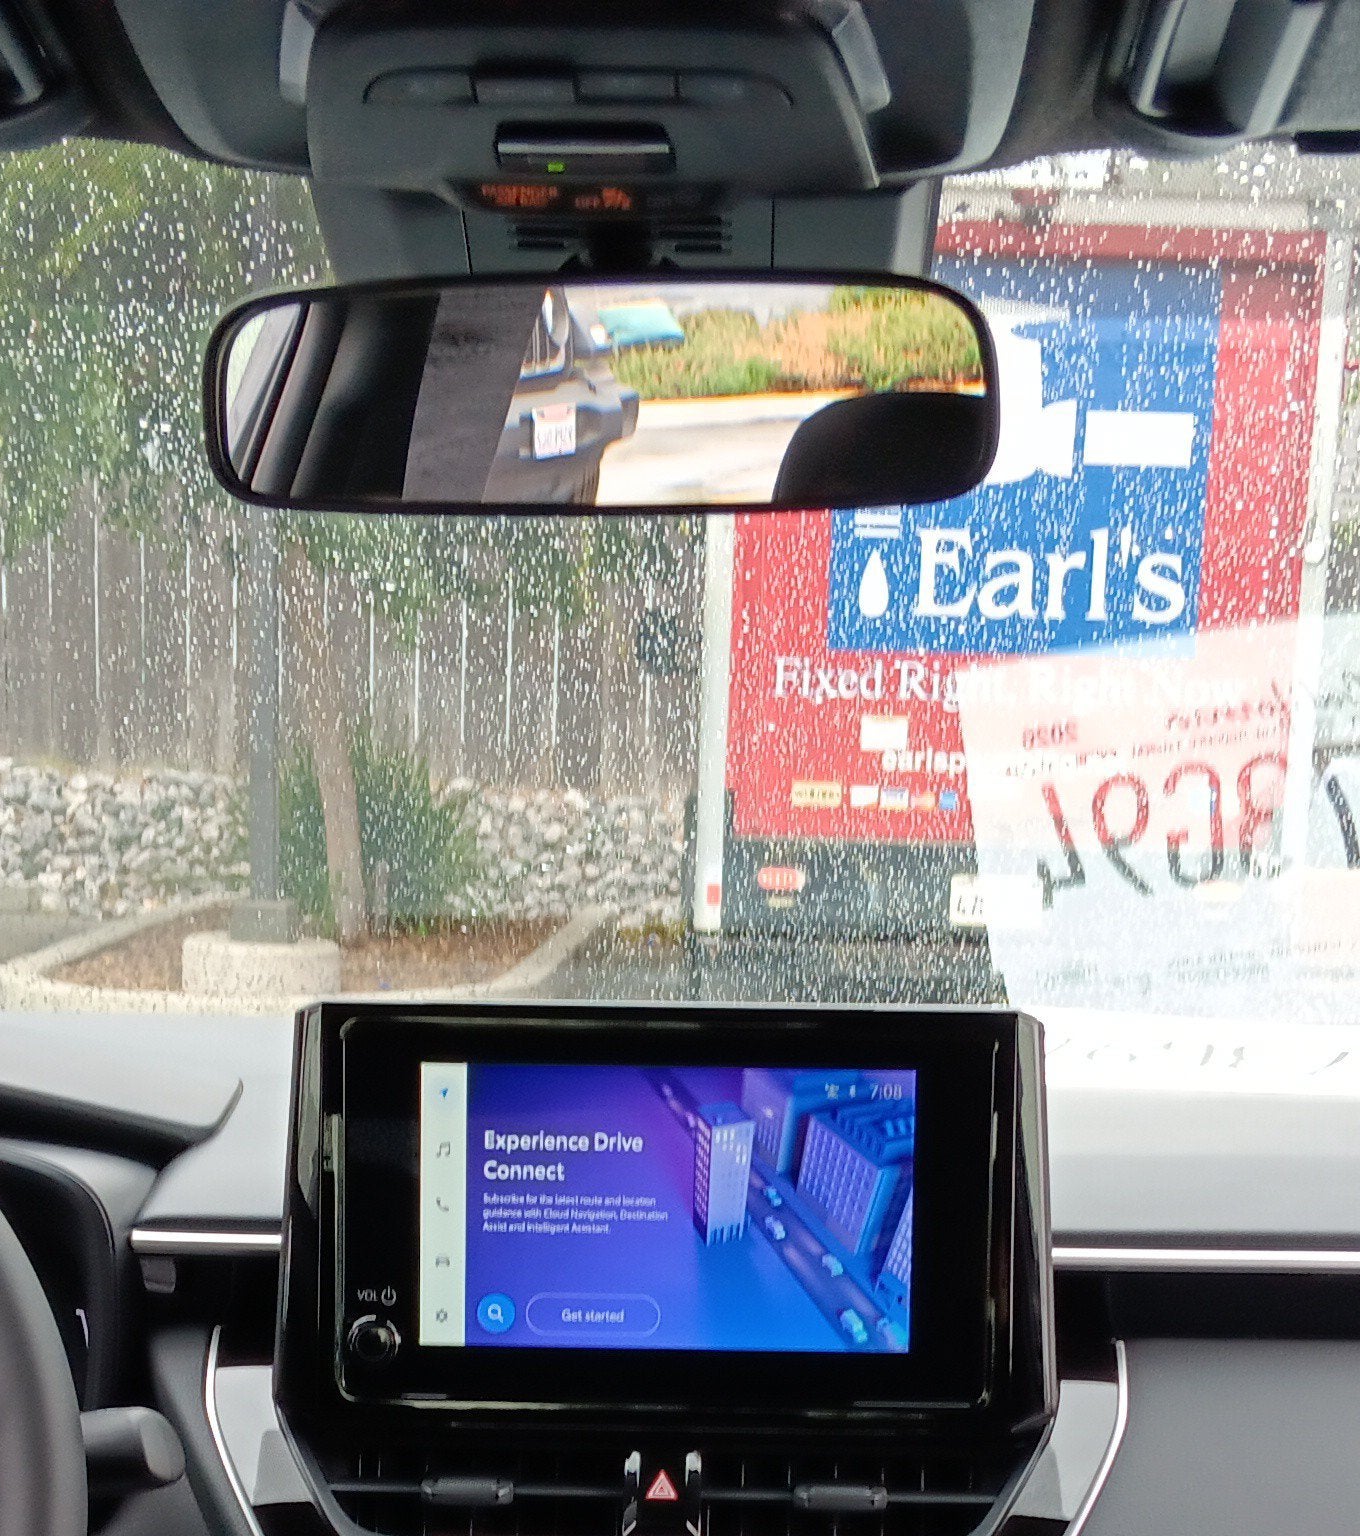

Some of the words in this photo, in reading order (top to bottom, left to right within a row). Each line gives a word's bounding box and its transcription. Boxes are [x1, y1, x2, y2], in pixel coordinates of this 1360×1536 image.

[911, 525, 1187, 625] Earl's
[774, 655, 883, 702] Fixed
[484, 1129, 590, 1155] Experience
[594, 1131, 644, 1153] Drive
[483, 1159, 566, 1182] Connect
[604, 1195, 621, 1207] and
[356, 1289, 379, 1302] VOL
[561, 1308, 583, 1323] Get
[584, 1308, 625, 1323] started
